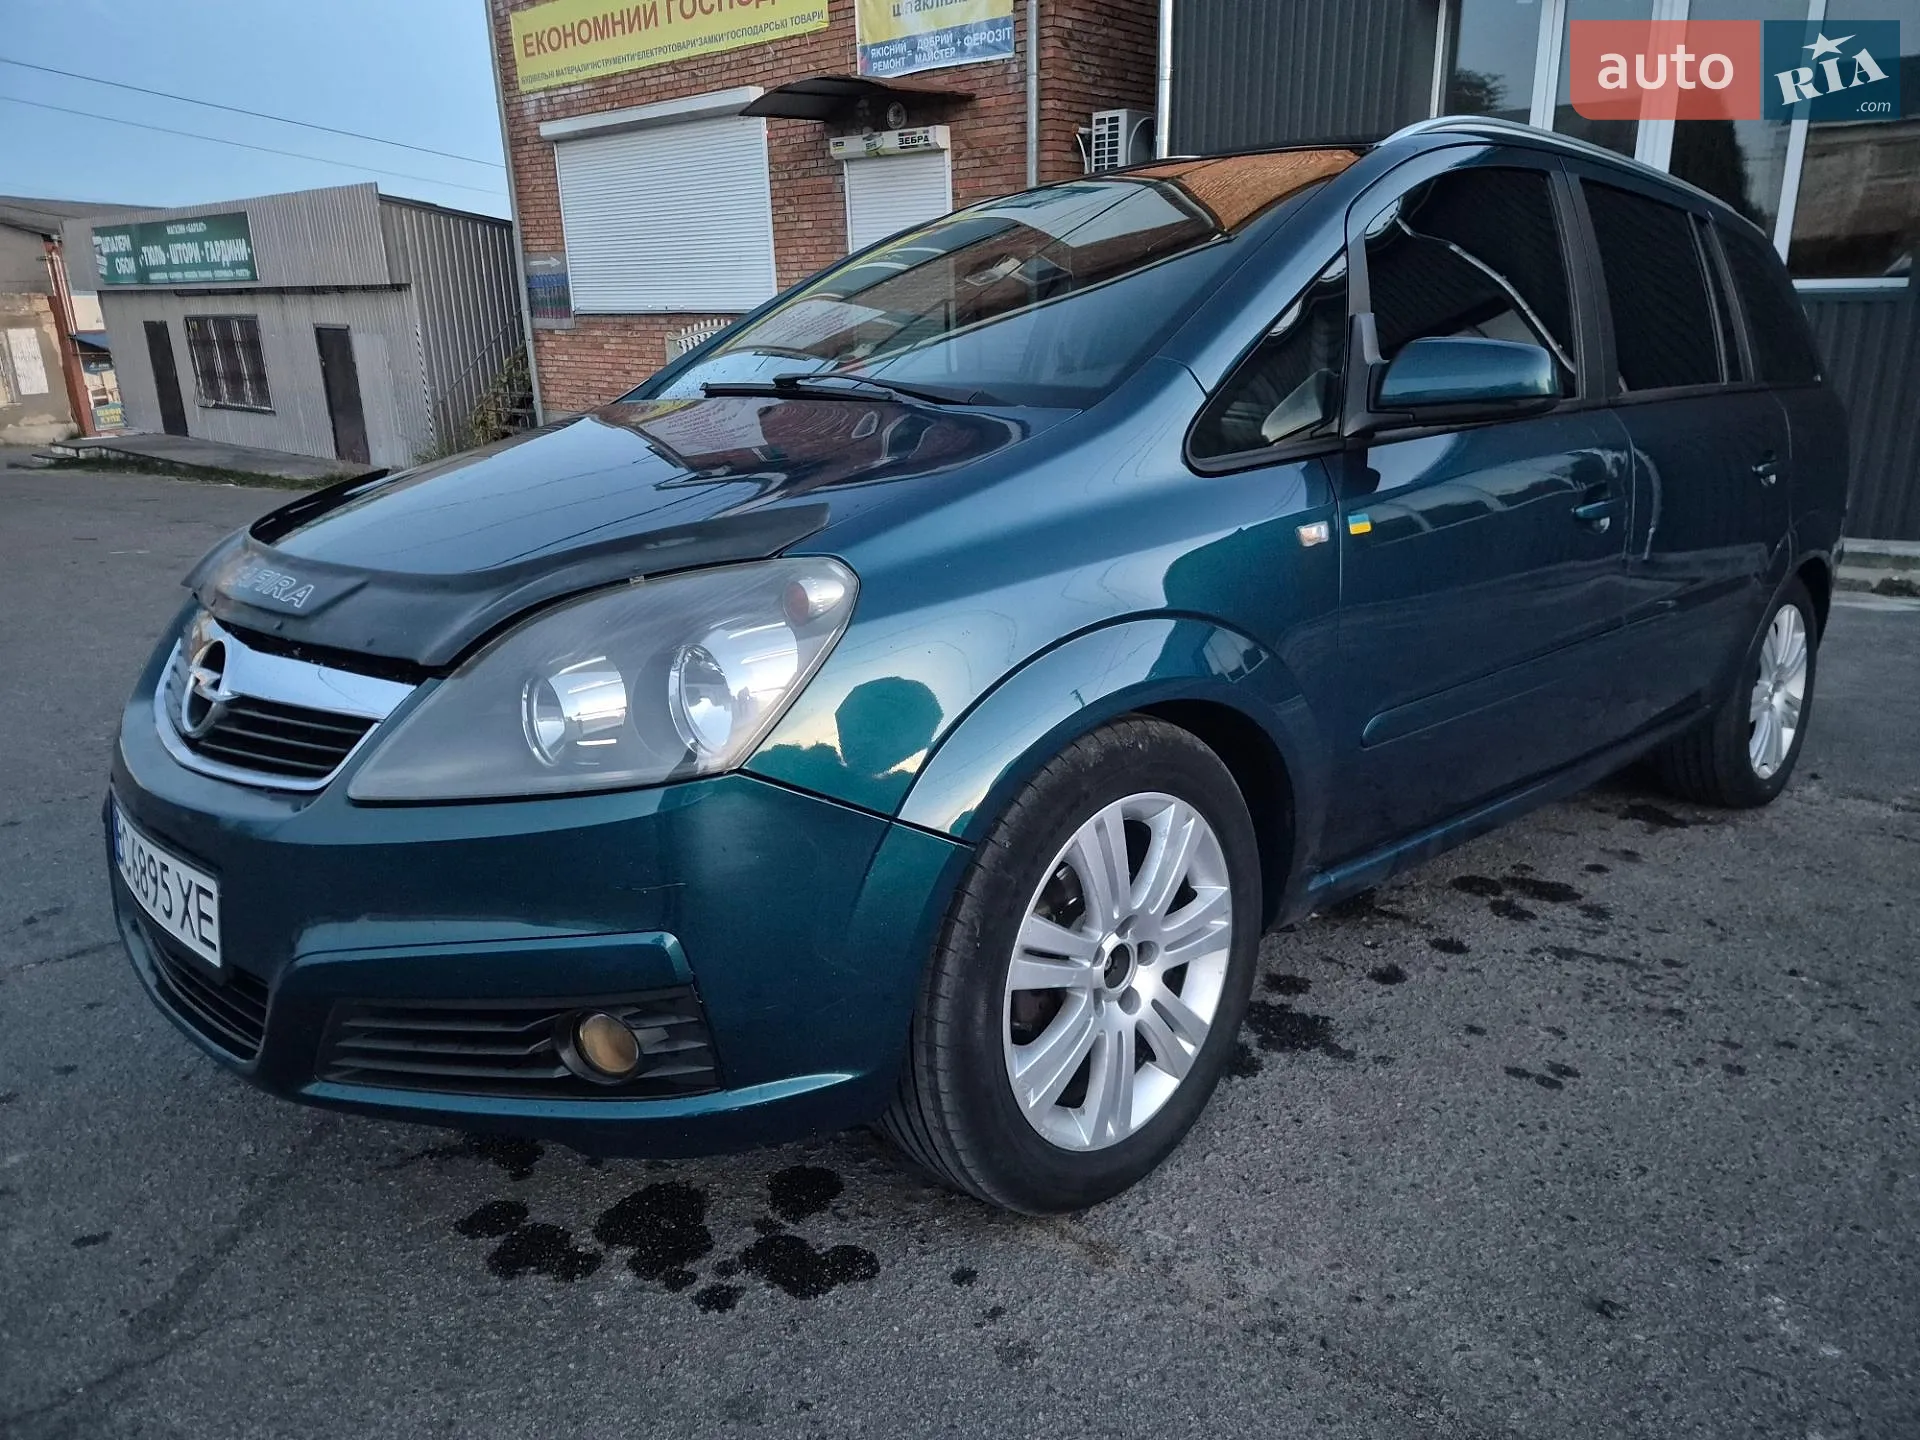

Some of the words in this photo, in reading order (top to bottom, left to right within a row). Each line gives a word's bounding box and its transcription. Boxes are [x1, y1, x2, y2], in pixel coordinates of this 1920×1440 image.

[522, 0, 659, 58] ЕКОНОМНИЙ
[790, 10, 824, 27] ТОВАРИ
[870, 41, 907, 59] ЯКІСНИЙ
[916, 33, 953, 51] ДОБРИЙ
[963, 27, 1012, 47] ФЕРОЗІТ
[872, 58, 905, 72] РЕМОНТ
[914, 47, 956, 64] МАЙСТЕР
[898, 134, 929, 146] ЗЕБРА
[169, 241, 201, 265] ШТОРИ
[228, 566, 314, 608] FIRA
